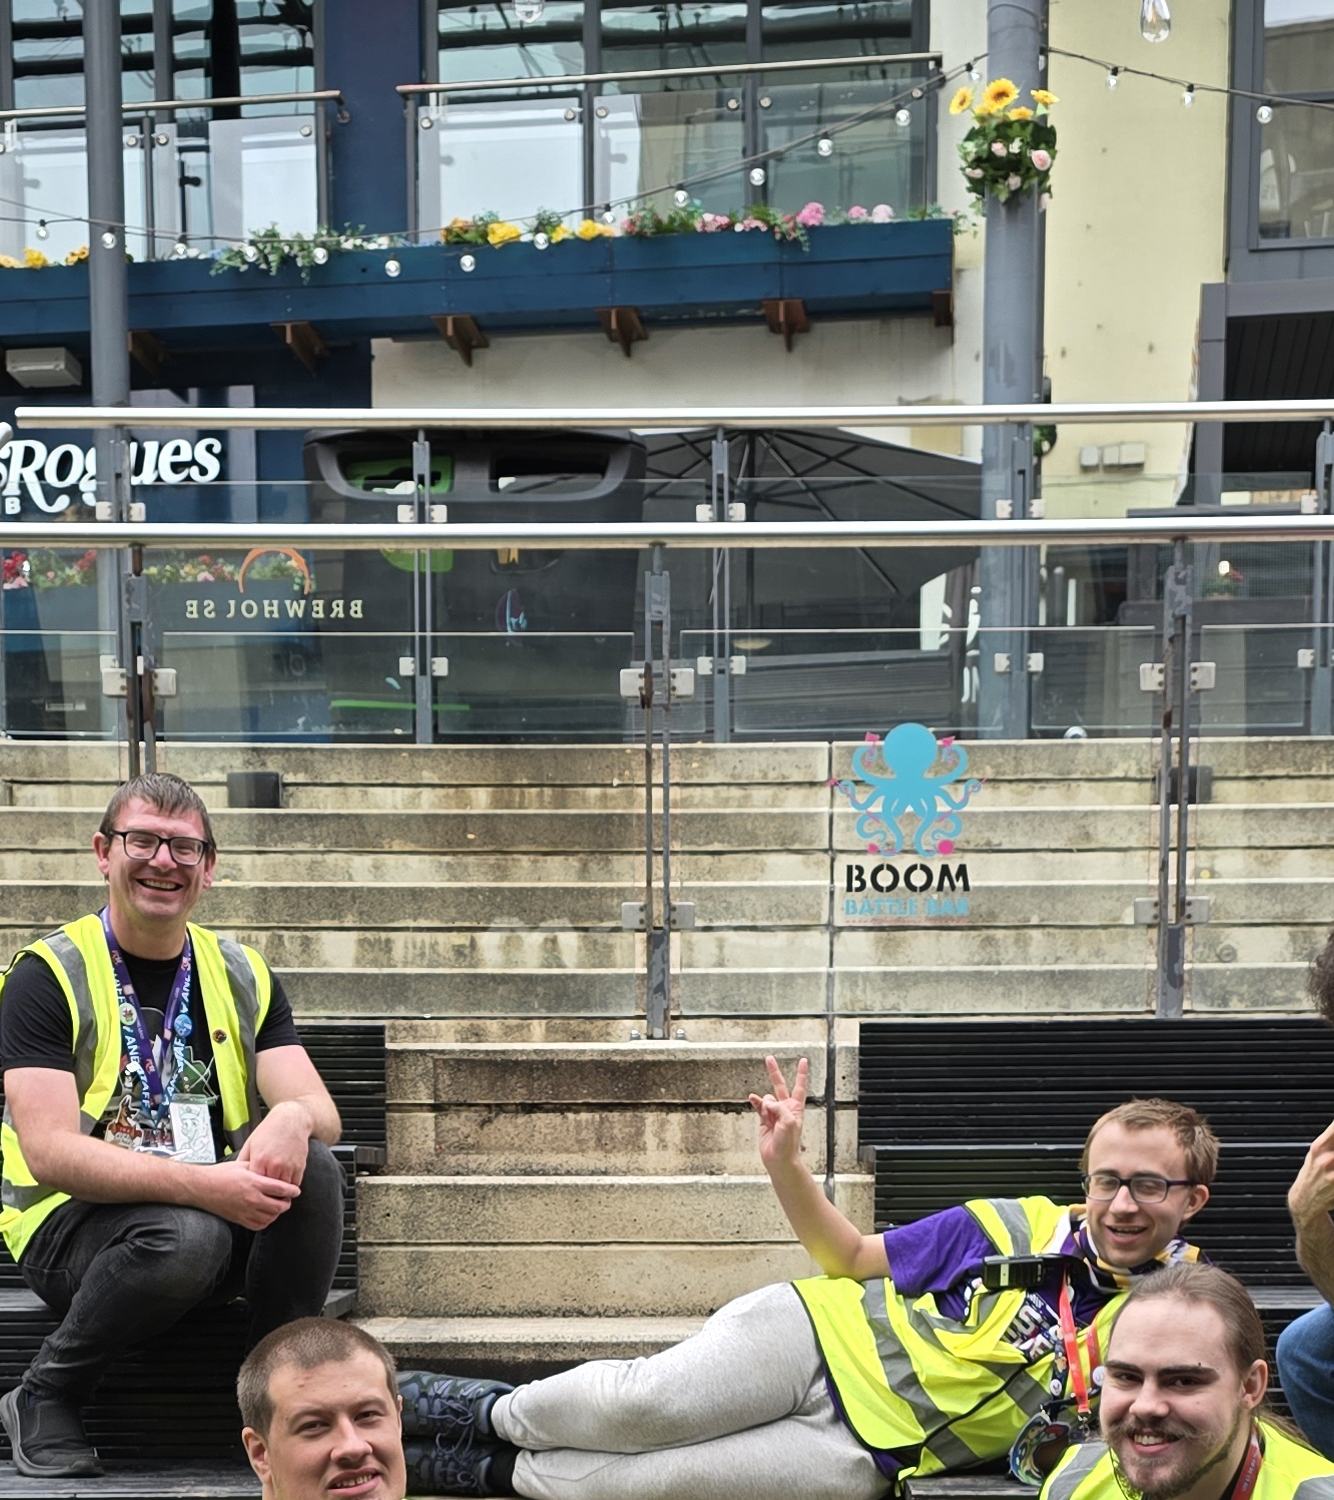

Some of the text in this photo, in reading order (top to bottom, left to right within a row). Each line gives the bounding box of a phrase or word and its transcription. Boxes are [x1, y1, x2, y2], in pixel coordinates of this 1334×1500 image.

[845, 863, 971, 894] BOOM
[844, 898, 971, 916] BATTLE BAR
